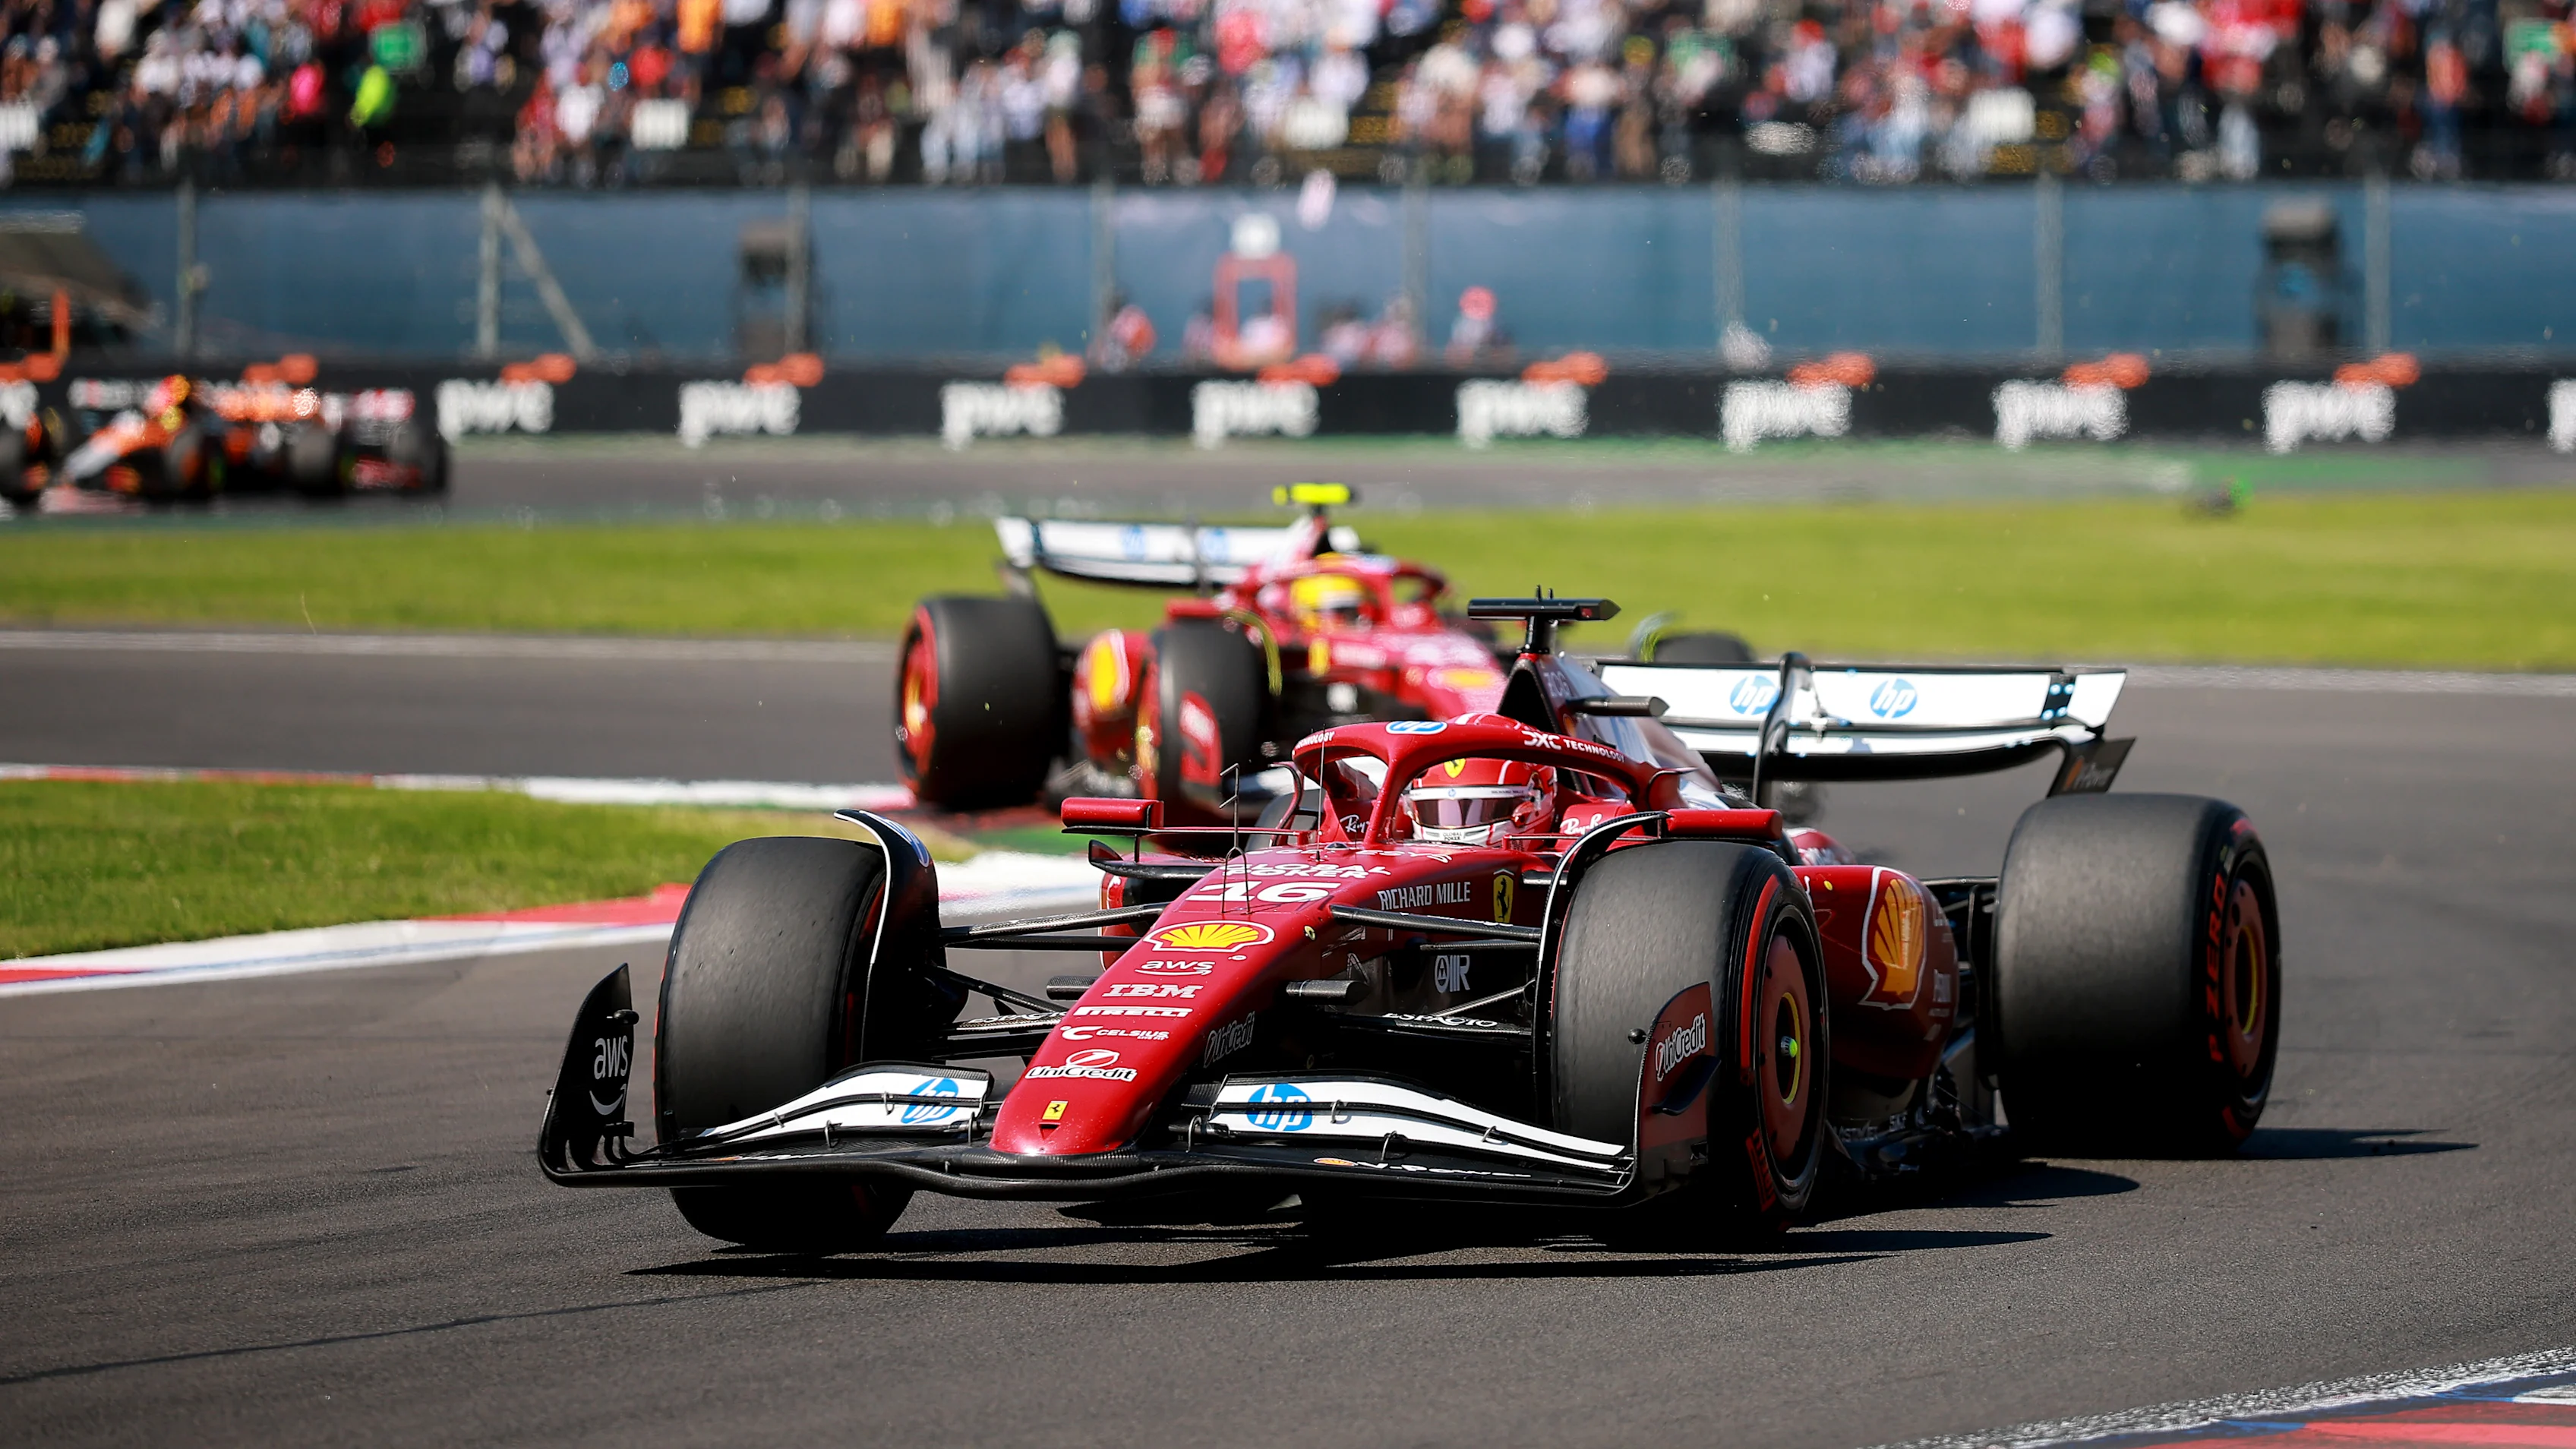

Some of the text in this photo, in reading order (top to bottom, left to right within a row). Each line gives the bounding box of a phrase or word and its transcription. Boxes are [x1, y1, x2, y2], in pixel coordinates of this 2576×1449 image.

[1732, 675, 1775, 715] hp
[1873, 677, 1915, 718] hp
[1521, 730, 1625, 762] DXC TECHNOLOGY
[1560, 813, 1602, 835] Ray-B
[1185, 880, 1342, 903] 16
[1376, 881, 1471, 911] RICHARD MILLE
[1139, 959, 1217, 971] aws
[1101, 983, 1204, 999] IBM
[1073, 1005, 1194, 1018] PIRELLI
[1096, 1028, 1170, 1037] CELSIUS
[1664, 1012, 1706, 1074] UniCredit
[594, 1035, 628, 1080] aws
[1026, 1066, 1136, 1081] UniCredit
[903, 1077, 957, 1124] hp
[1251, 1083, 1310, 1131] hp
